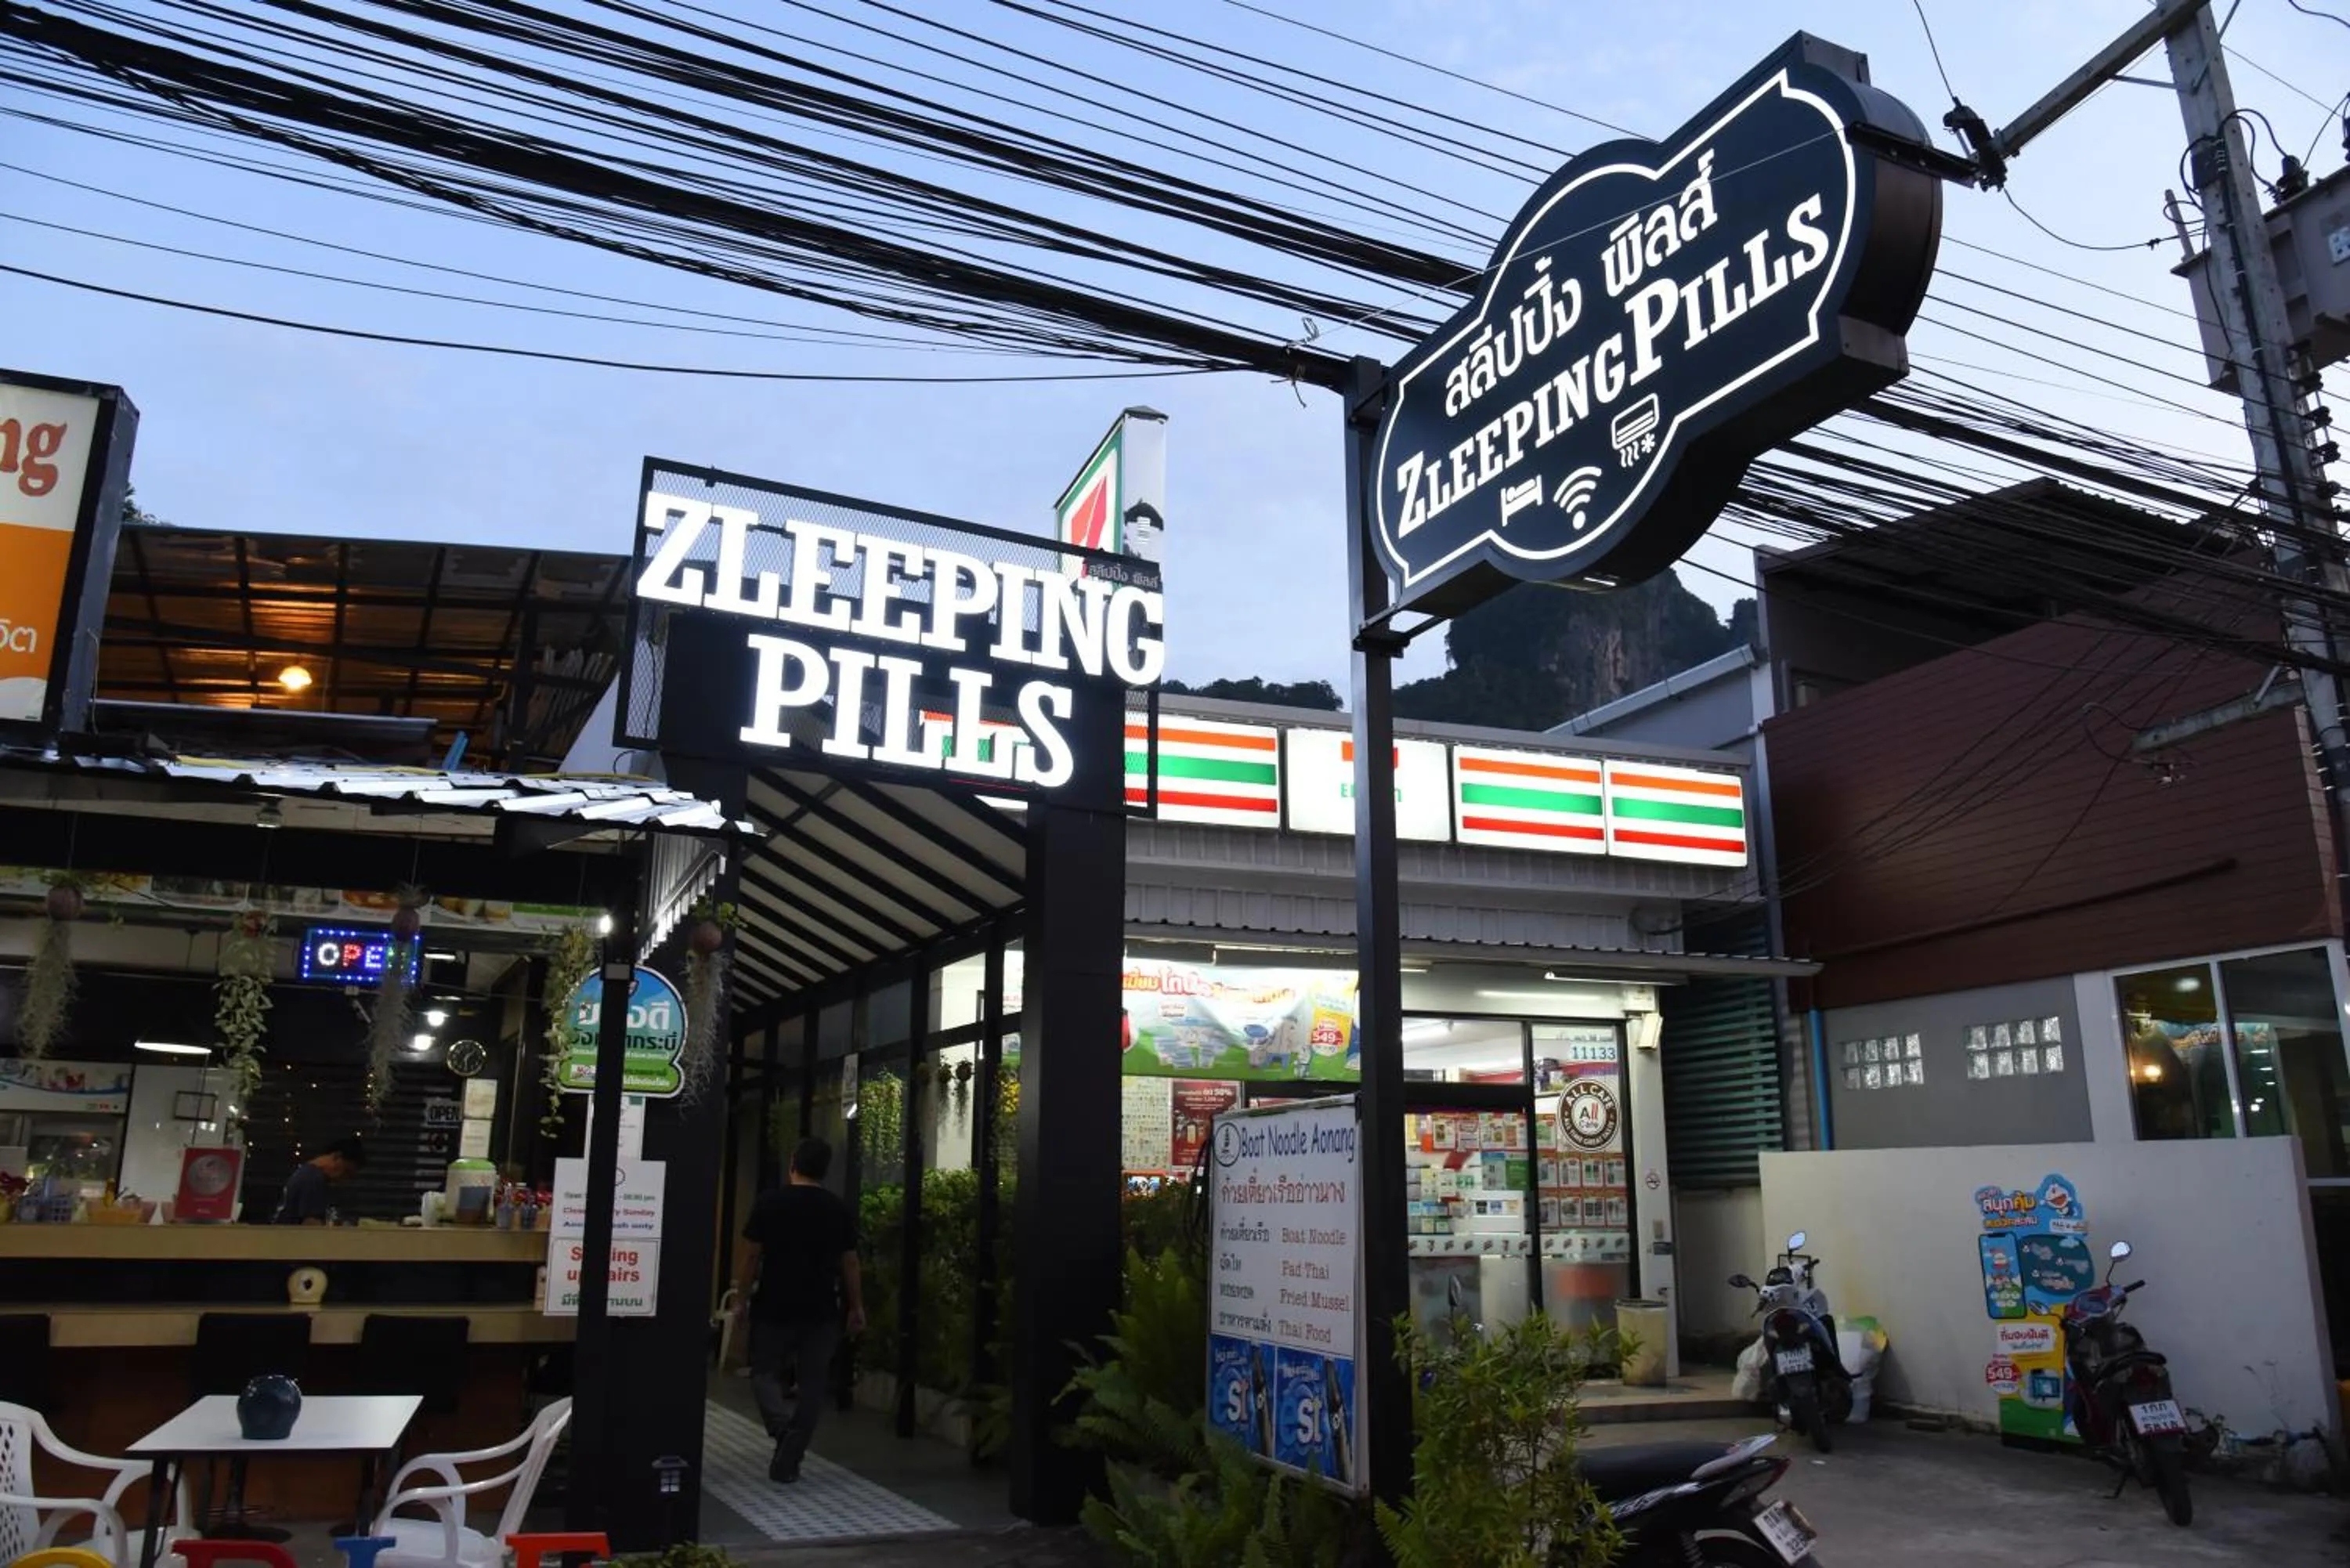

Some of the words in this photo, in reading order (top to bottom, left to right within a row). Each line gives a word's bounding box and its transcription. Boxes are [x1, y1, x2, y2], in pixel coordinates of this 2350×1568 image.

[1397, 334, 1625, 539] ZLEEPING
[1624, 193, 1830, 386] PILLS
[636, 491, 1165, 686] ZLEEPING
[739, 633, 1074, 789] PILLS
[1572, 1045, 1616, 1060] 11133
[1241, 1126, 1265, 1158] Boat
[1268, 1121, 1307, 1157] Noodle
[1311, 1122, 1354, 1164] Aonang
[1282, 1227, 1306, 1244] Boat
[1309, 1228, 1347, 1245] Noodle
[570, 1246, 638, 1266] Sing
[1282, 1259, 1302, 1277] Pad
[1304, 1261, 1330, 1280] Thai
[1279, 1288, 1308, 1307] Fried
[1311, 1291, 1351, 1312] Mussel
[1278, 1318, 1303, 1338] Thai
[1305, 1322, 1332, 1344] Food
